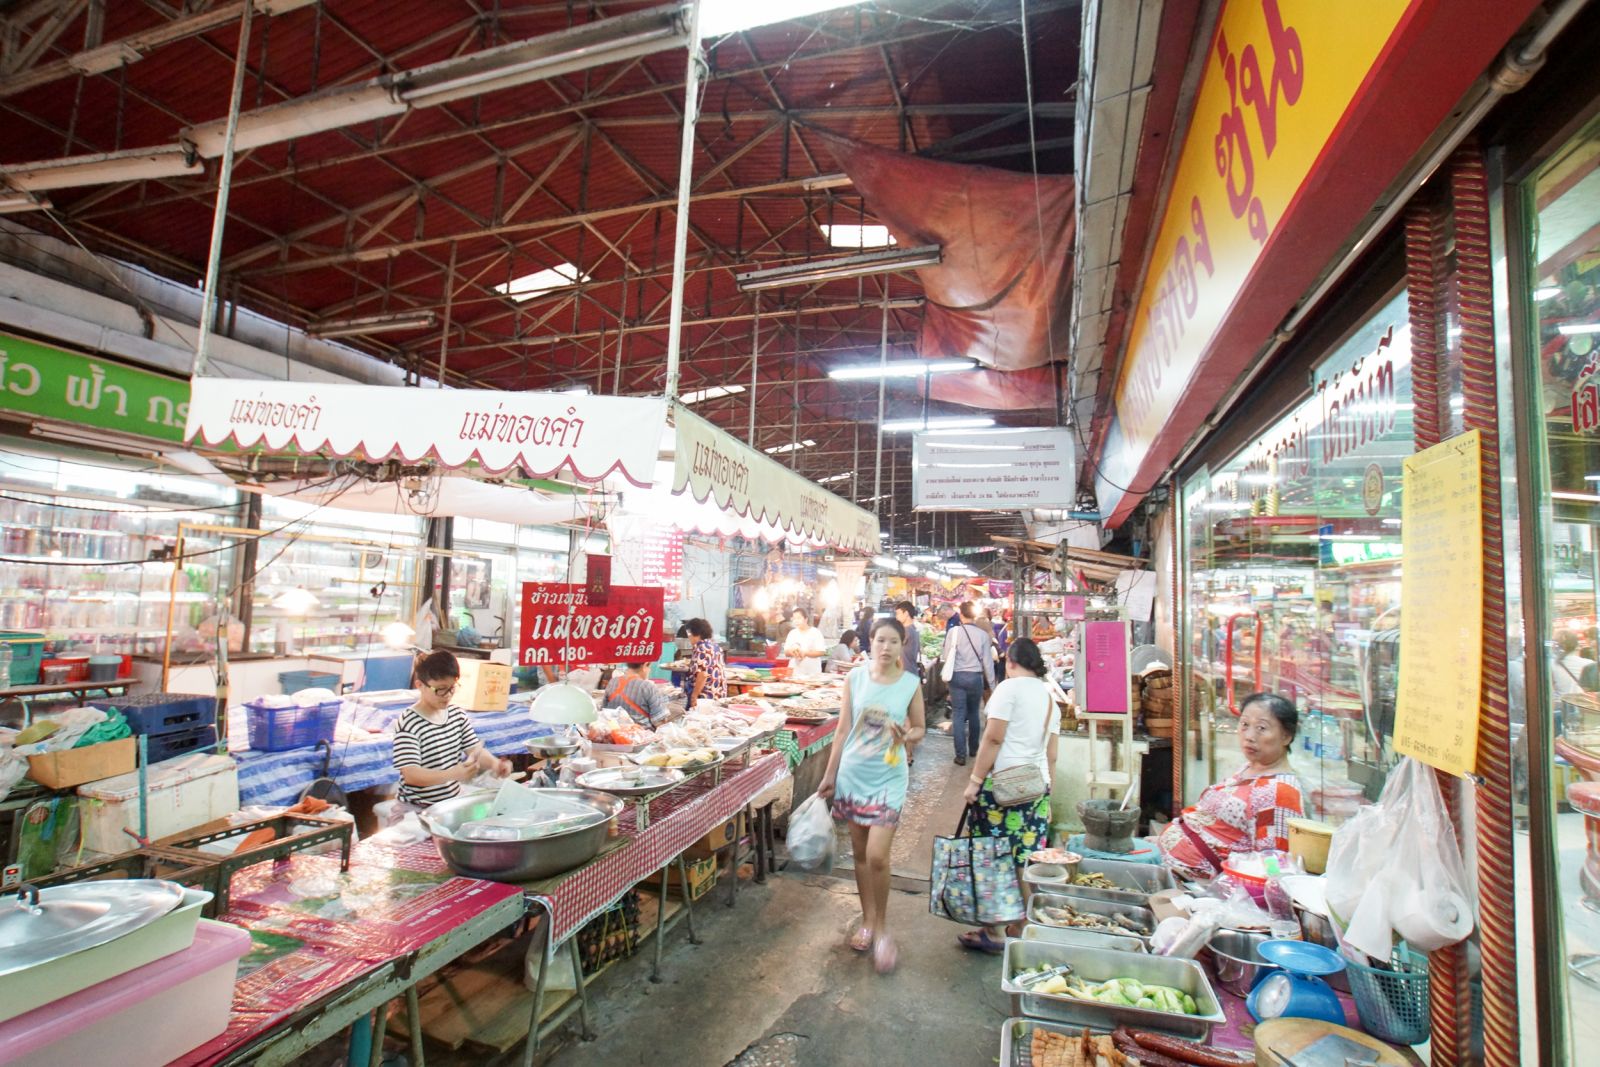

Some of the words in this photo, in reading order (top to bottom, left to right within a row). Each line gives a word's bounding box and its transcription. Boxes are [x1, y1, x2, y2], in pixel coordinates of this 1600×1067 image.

[229, 391, 321, 431] แม่ทองคำ
[458, 401, 585, 448] แม่ทองคำ
[692, 439, 750, 496] แม่ทองคำ
[531, 605, 655, 641] แม่ทองคำ
[614, 640, 656, 657] รสเลิศ
